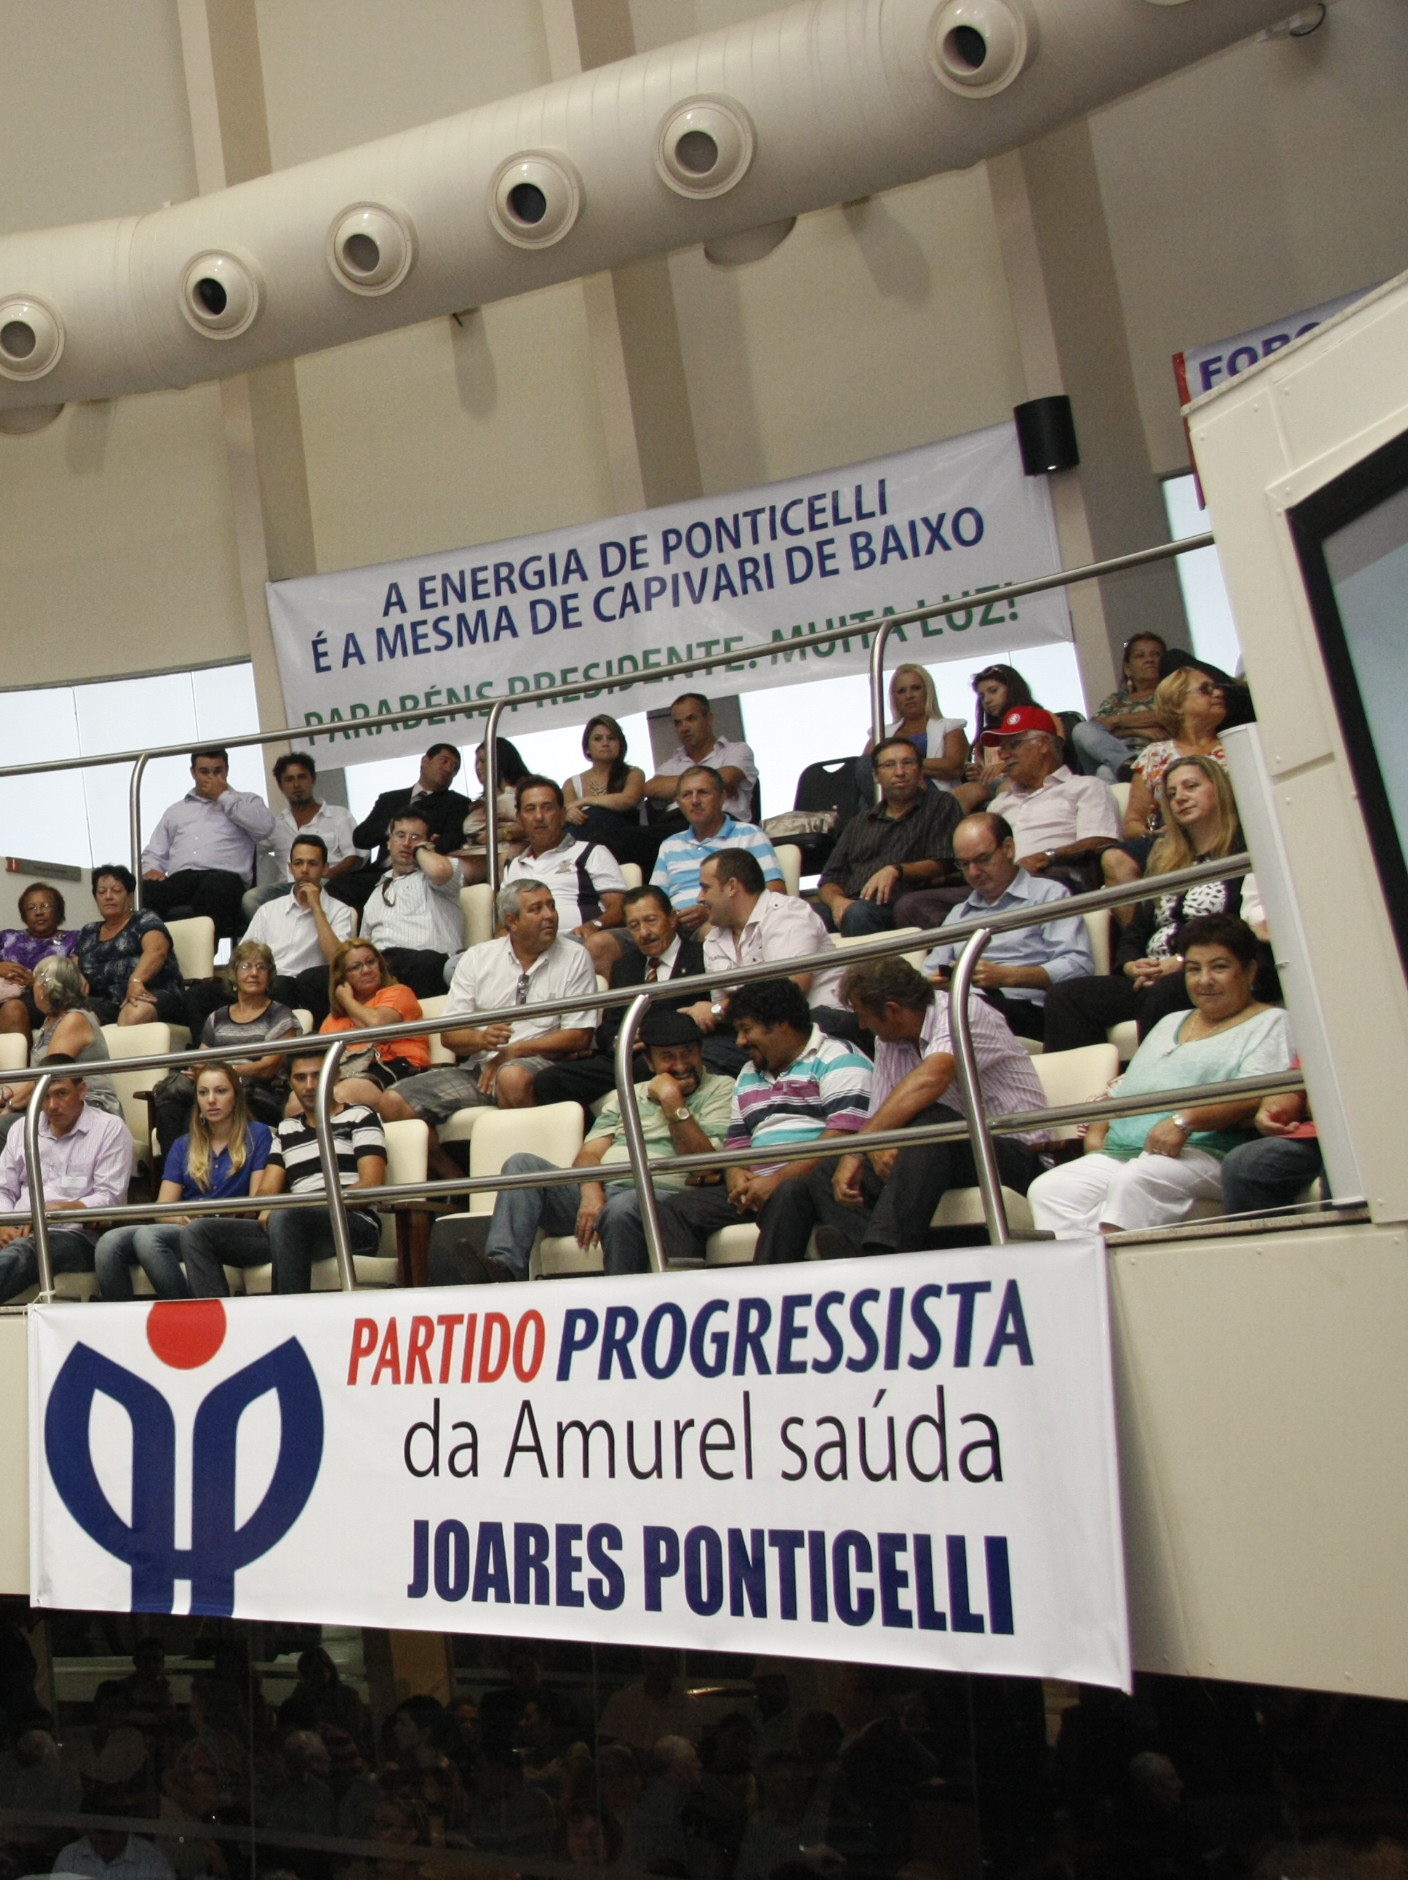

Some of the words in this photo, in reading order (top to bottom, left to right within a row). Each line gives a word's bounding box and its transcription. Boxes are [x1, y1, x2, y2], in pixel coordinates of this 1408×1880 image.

[311, 631, 331, 673] É
[342, 633, 365, 668] A
[376, 605, 518, 661] MESMA
[529, 593, 582, 635] DE
[593, 553, 774, 622] CAPIVARI
[785, 538, 839, 584] DE
[850, 507, 984, 570] BAIXO
[383, 582, 407, 617] A
[419, 548, 588, 610] ENERGIA
[600, 535, 648, 578] DE
[662, 479, 887, 564] PONTICELLI
[347, 1310, 545, 1385] PARTIDO
[556, 1279, 1034, 1381] PROGRESSISTA
[404, 1398, 478, 1478] da
[504, 1391, 753, 1481] Amurel
[781, 1385, 1003, 1483] saúda
[407, 1519, 625, 1611] JOARES
[643, 1525, 1014, 1635] PONTICELLI
